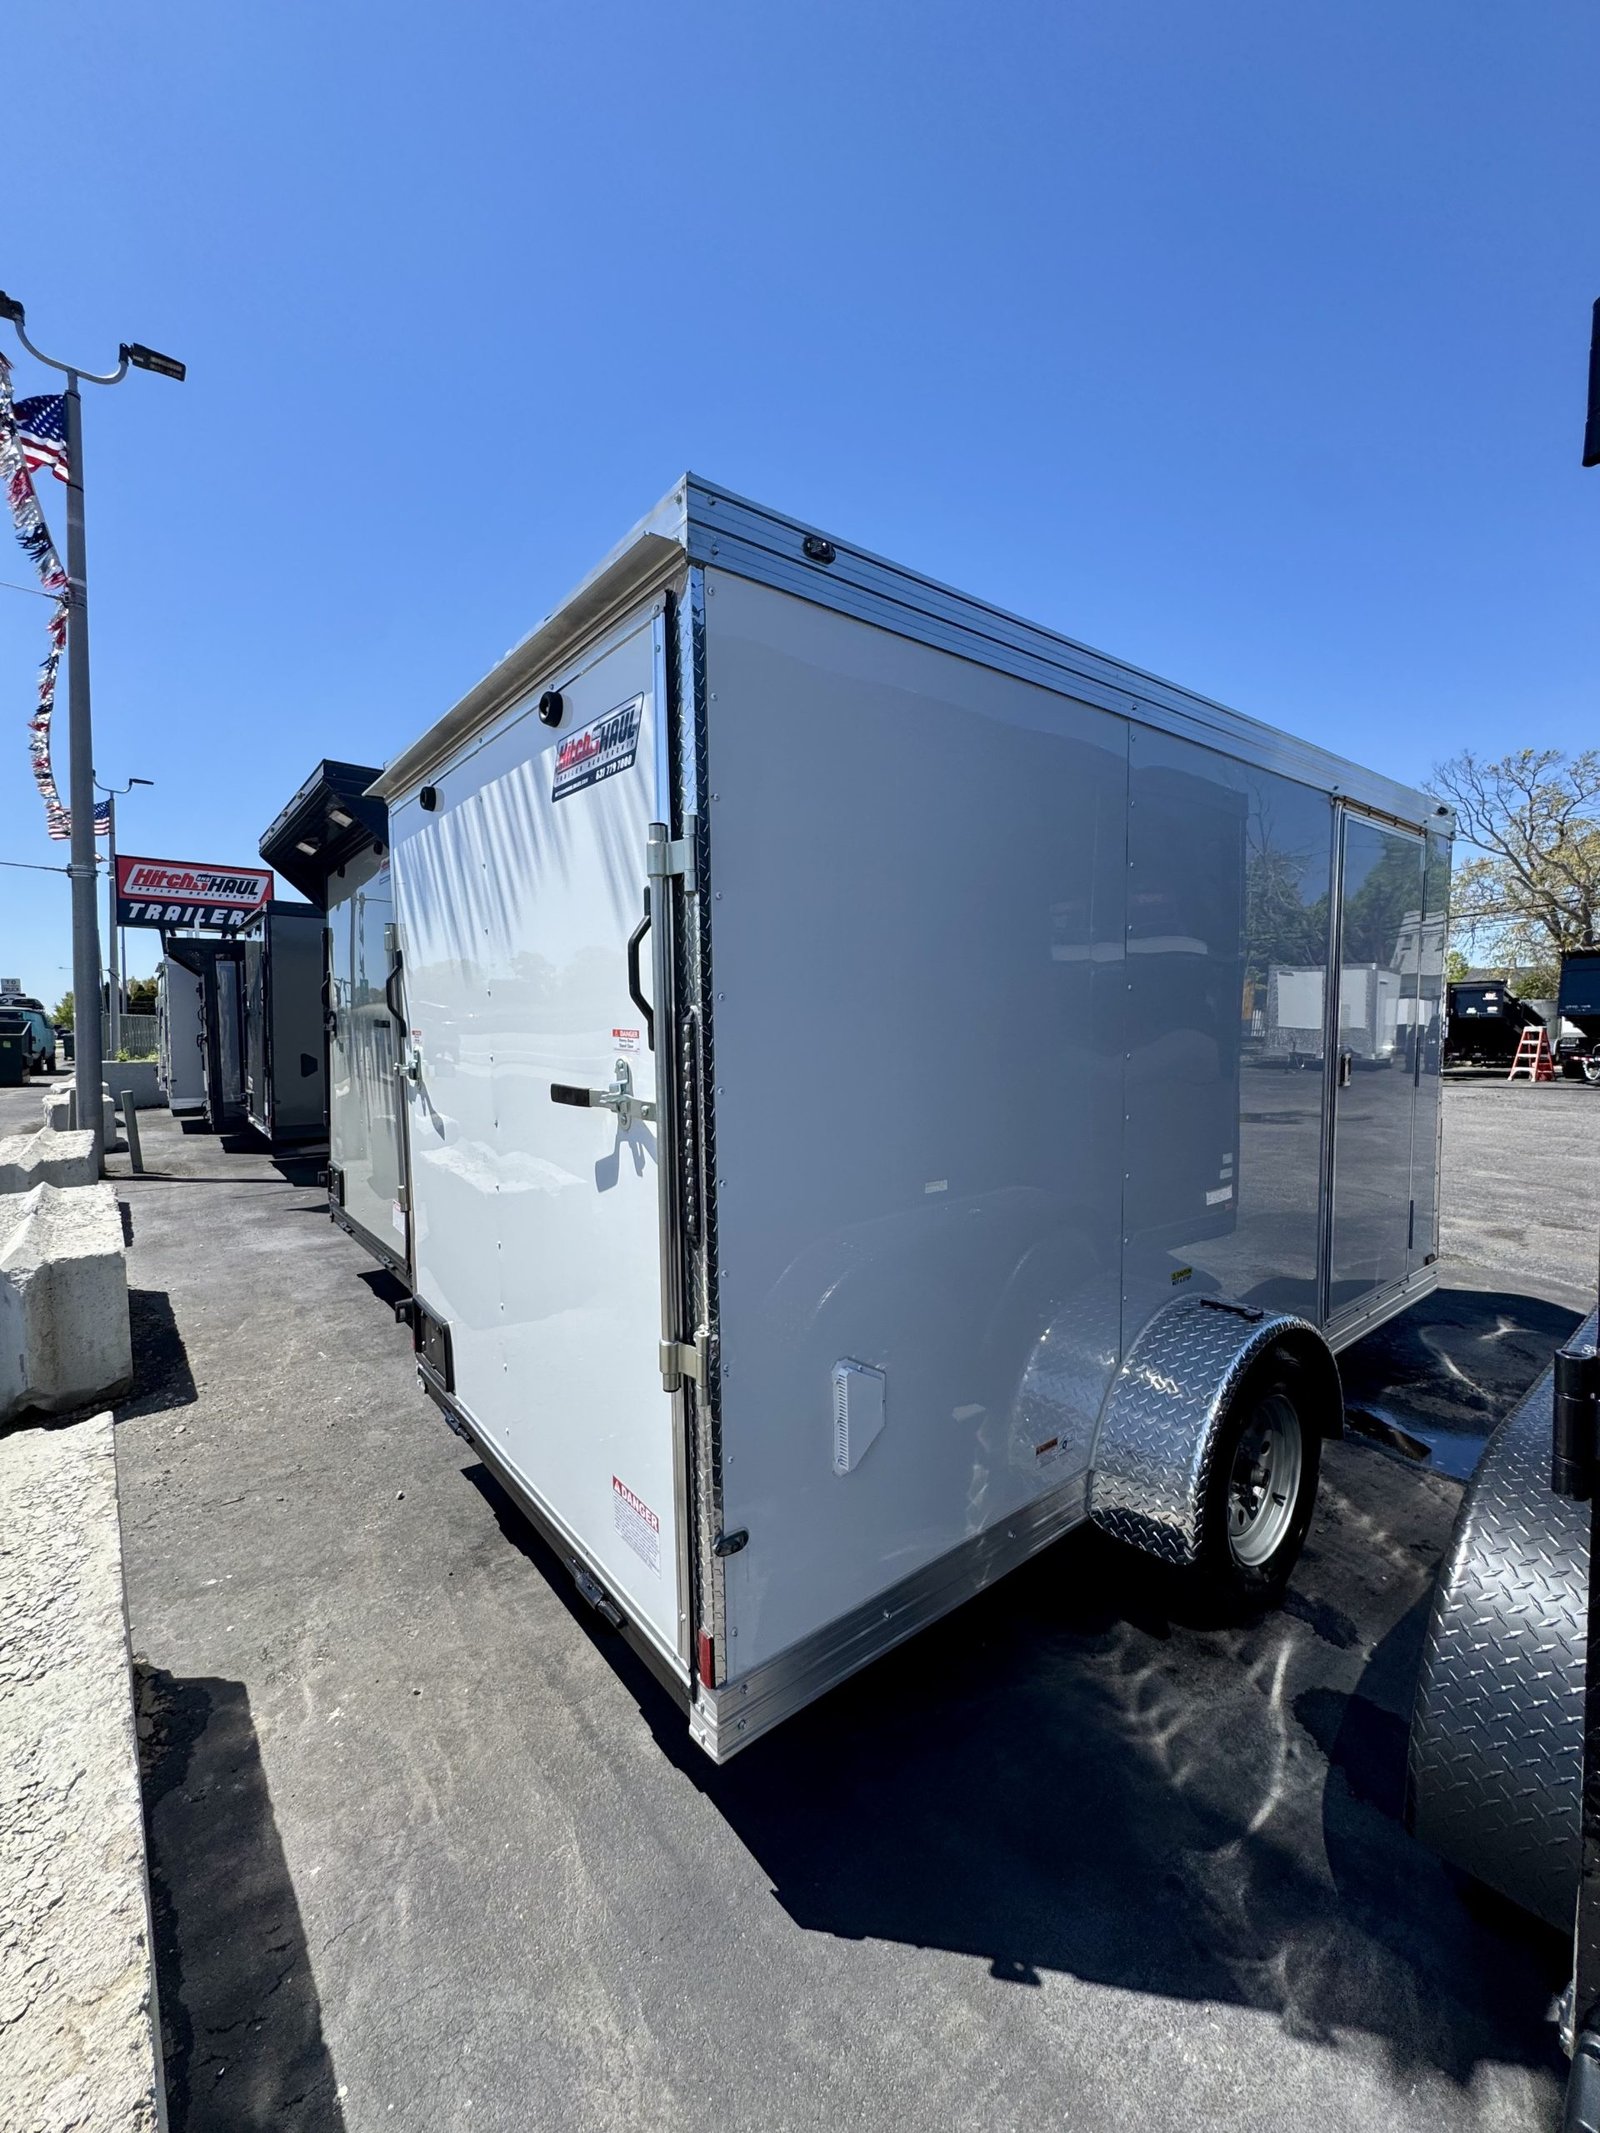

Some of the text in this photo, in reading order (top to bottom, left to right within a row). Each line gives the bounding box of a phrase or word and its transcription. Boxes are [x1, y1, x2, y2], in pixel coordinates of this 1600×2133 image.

[599, 709, 636, 753] HAUL
[133, 868, 196, 889] Hitch
[207, 878, 260, 895] HAUL
[129, 902, 248, 925] TRAILER
[621, 1484, 658, 1530] DANGER
